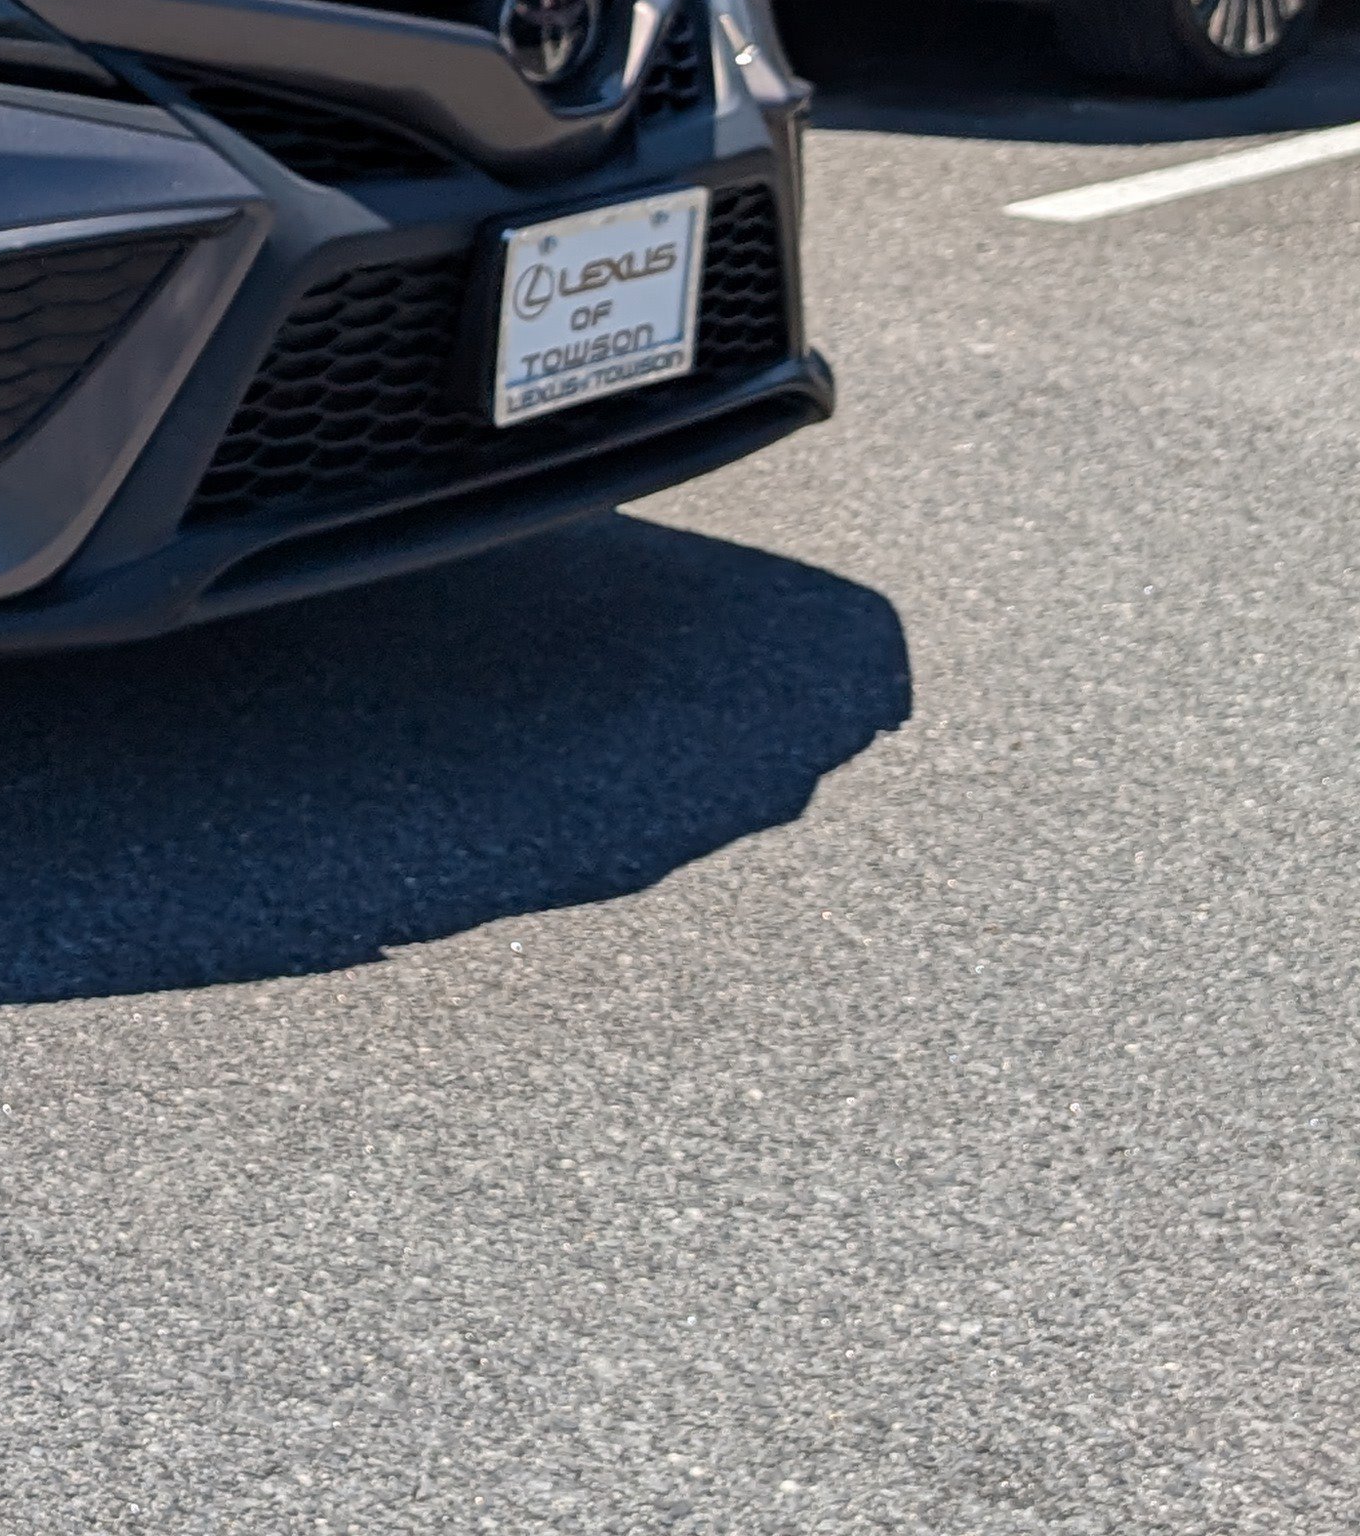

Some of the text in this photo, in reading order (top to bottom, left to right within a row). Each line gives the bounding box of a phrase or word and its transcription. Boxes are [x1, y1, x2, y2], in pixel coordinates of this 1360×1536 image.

[558, 241, 678, 298] LEXUS
[570, 299, 613, 331] OF
[520, 322, 654, 378] TOWSON
